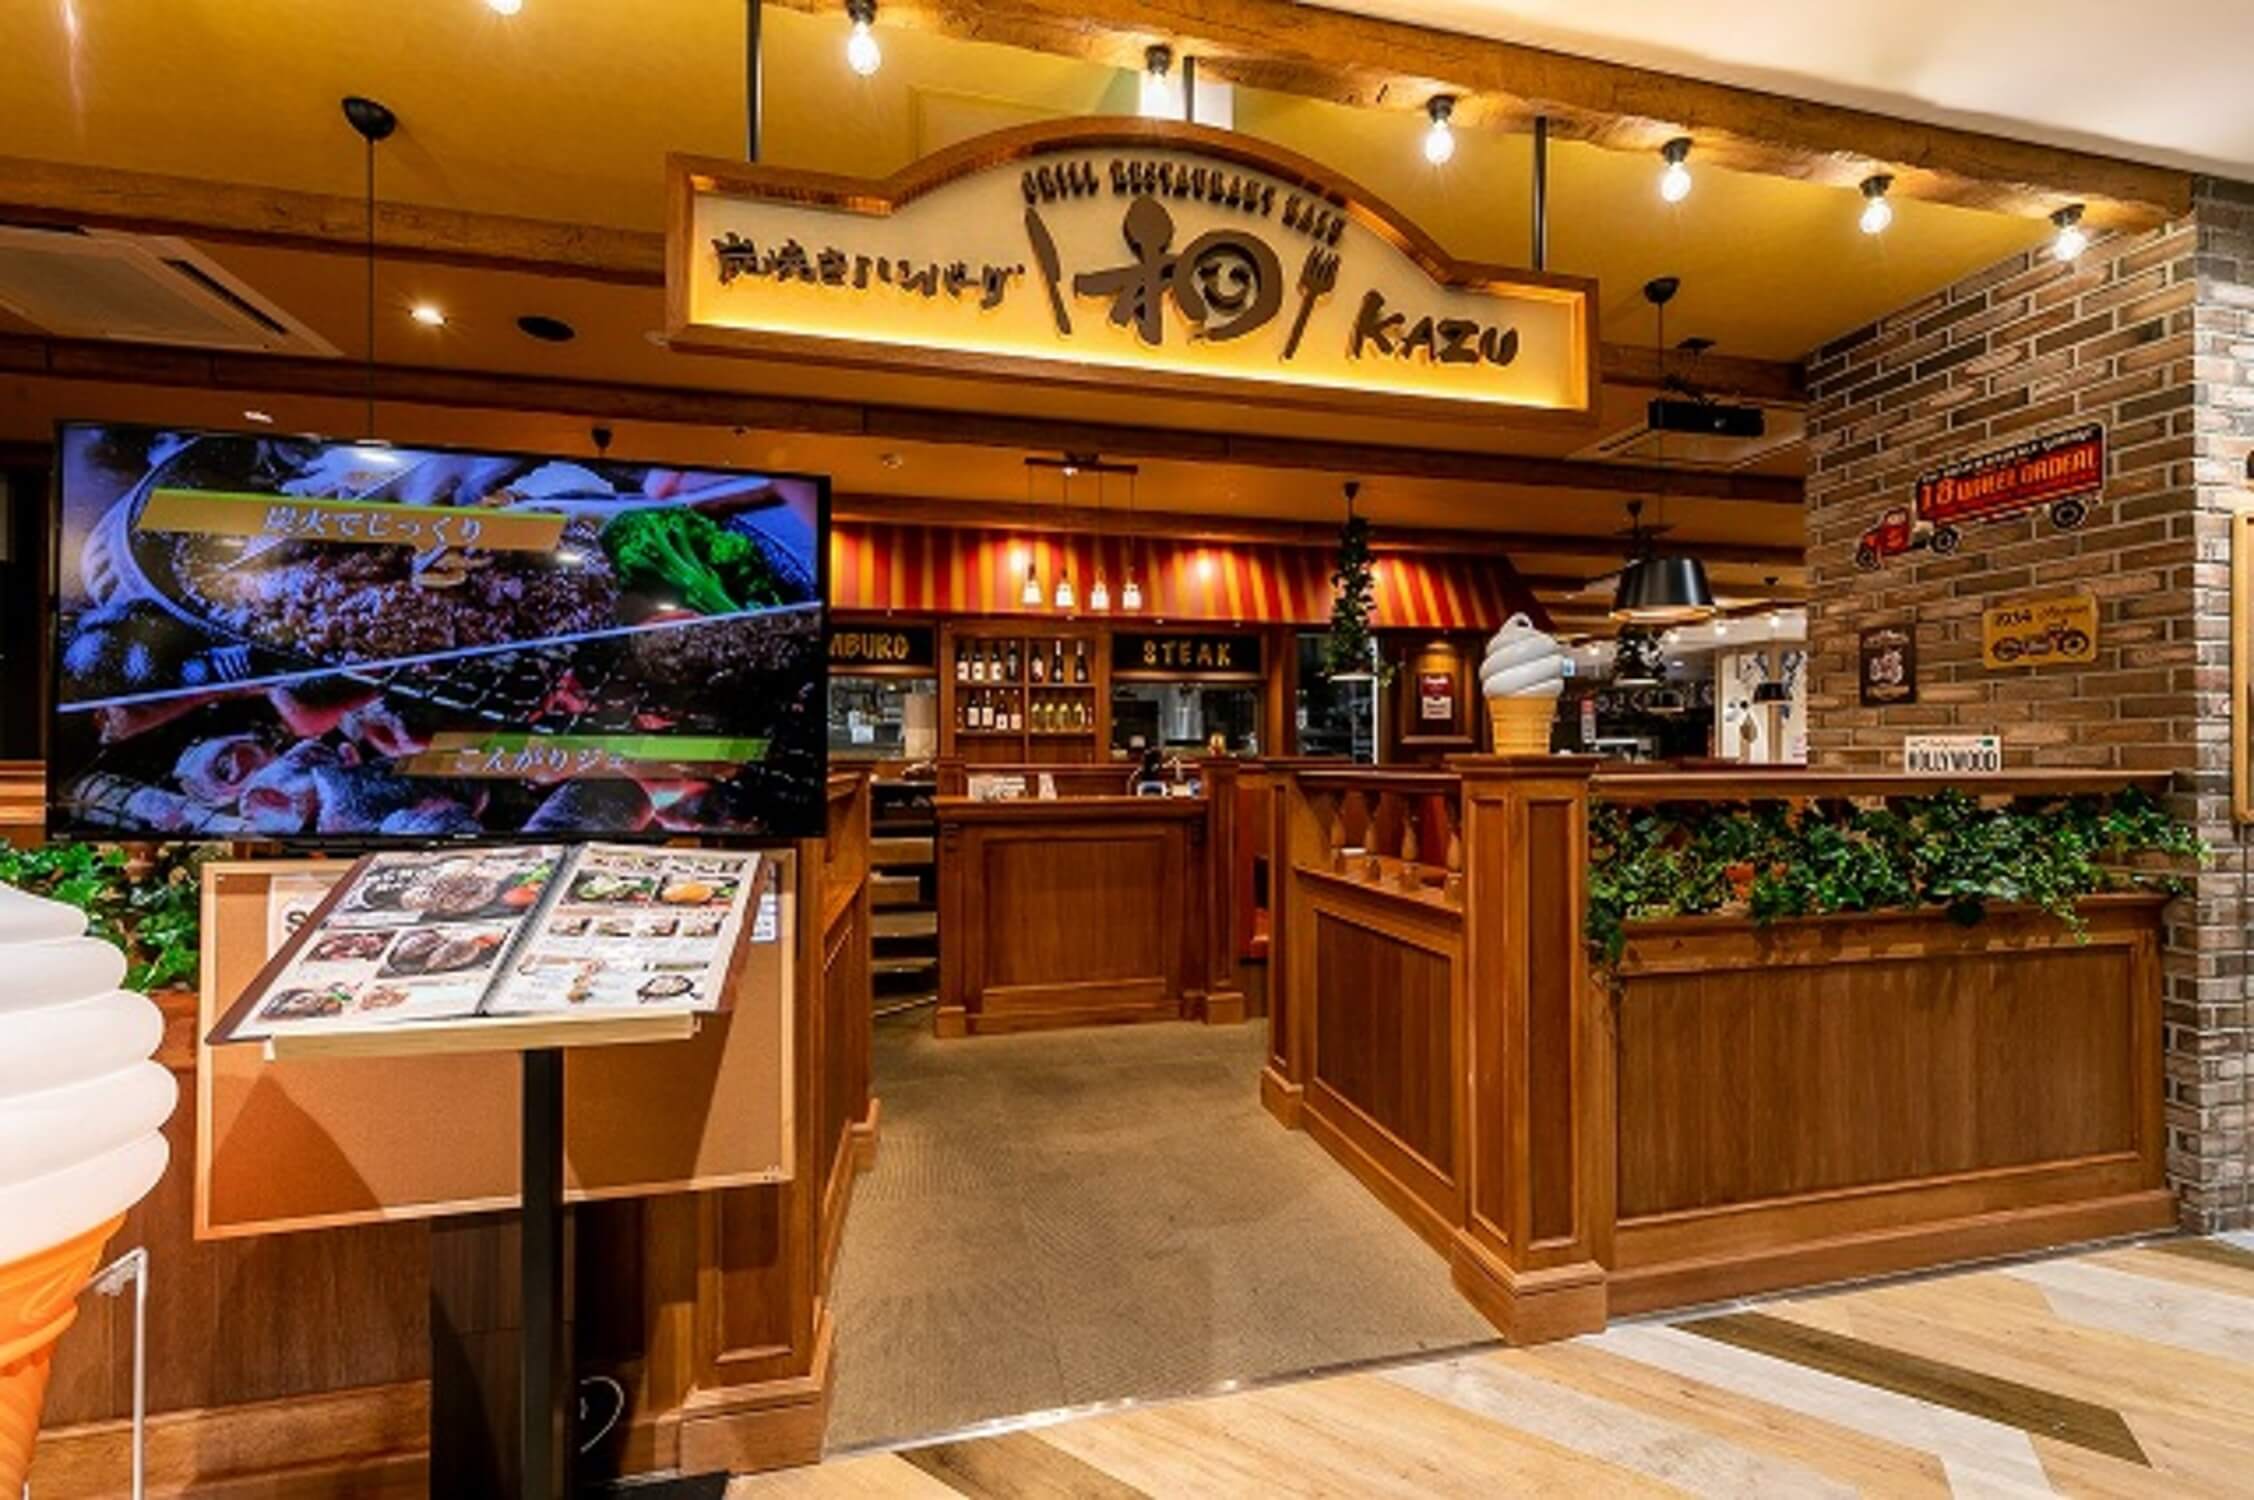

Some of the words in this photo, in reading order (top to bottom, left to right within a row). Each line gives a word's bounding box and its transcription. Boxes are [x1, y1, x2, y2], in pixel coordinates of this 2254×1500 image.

[1351, 289, 1519, 367] KAZU
[1143, 640, 1231, 667] STEAK
[1908, 750, 1998, 772] HOLLYWOOD
